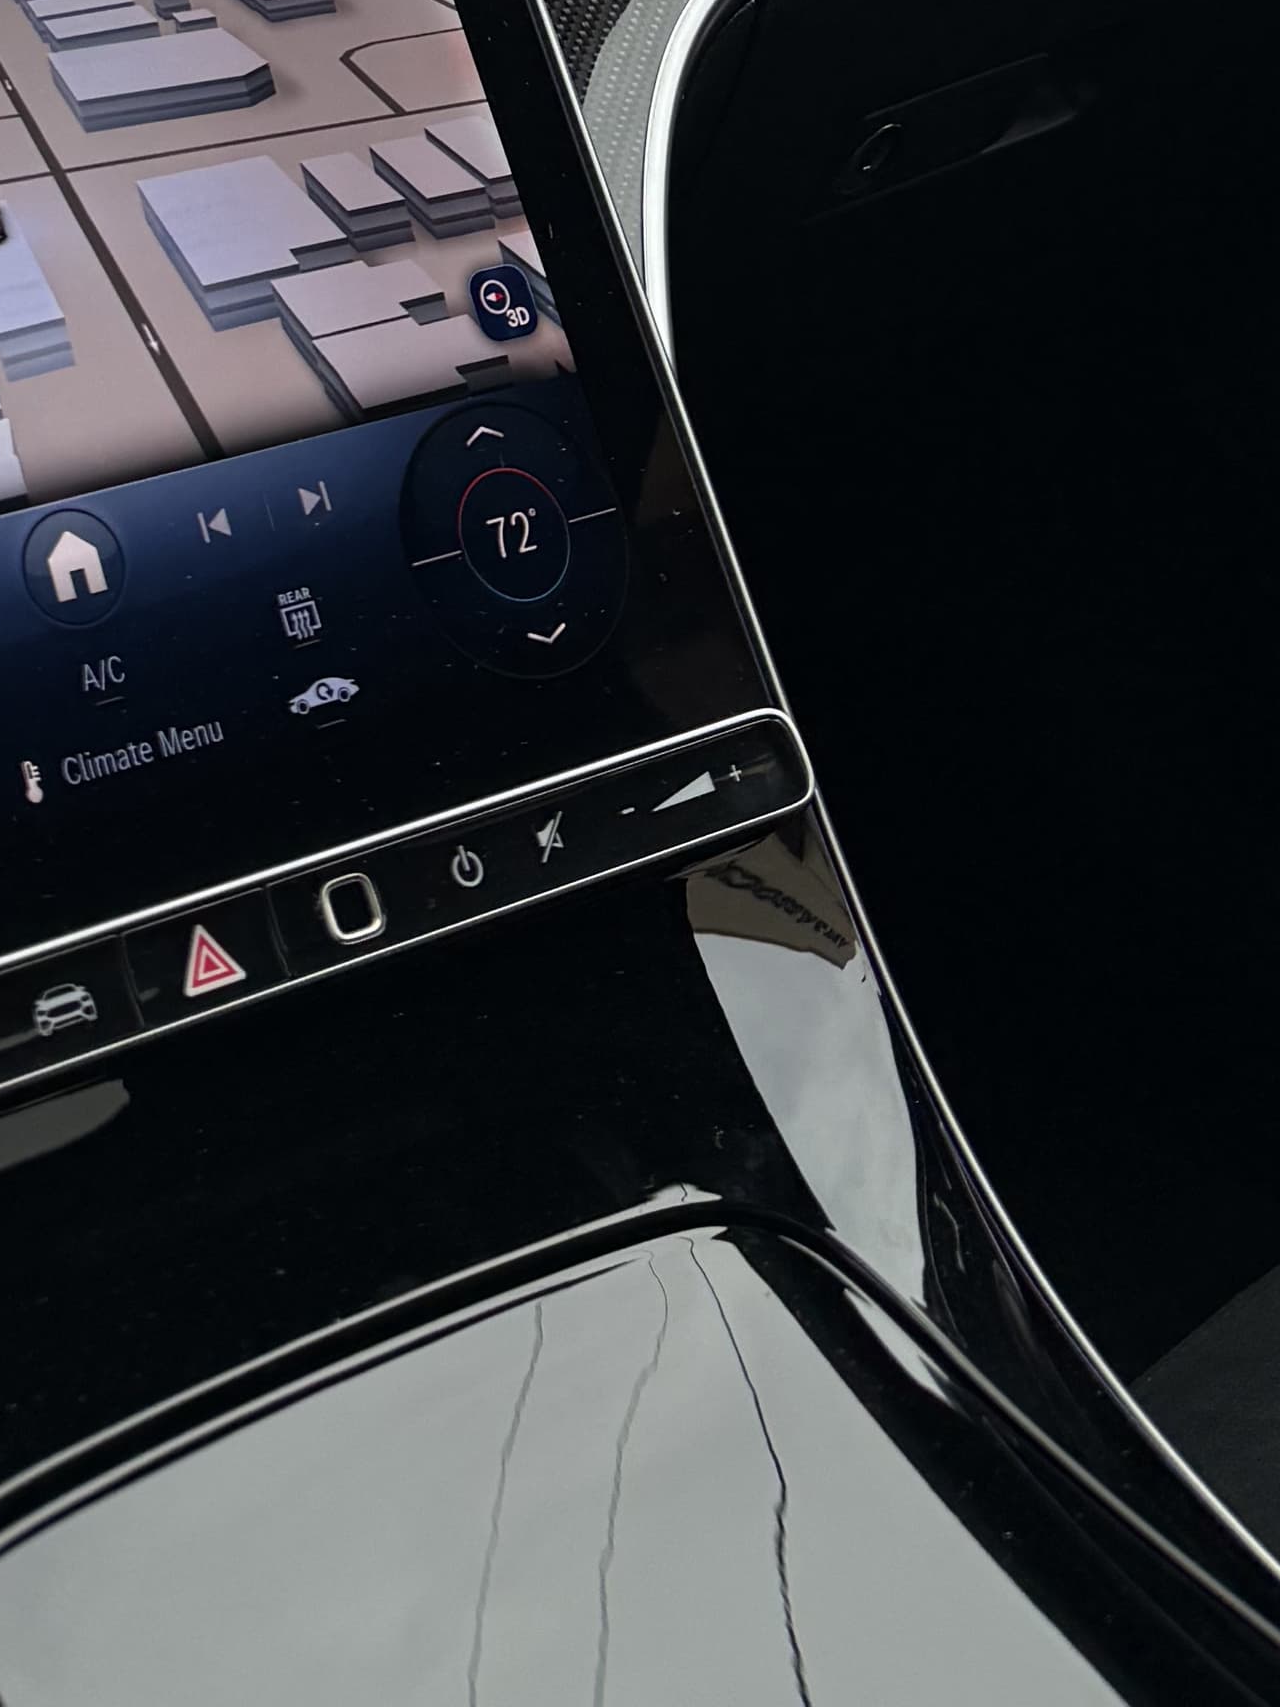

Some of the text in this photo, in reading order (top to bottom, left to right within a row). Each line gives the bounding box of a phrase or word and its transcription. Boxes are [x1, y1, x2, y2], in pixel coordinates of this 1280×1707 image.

[507, 307, 530, 326] 3D
[277, 587, 312, 606] REAR
[82, 654, 126, 692] A/C
[61, 719, 224, 786] Climate Menu
